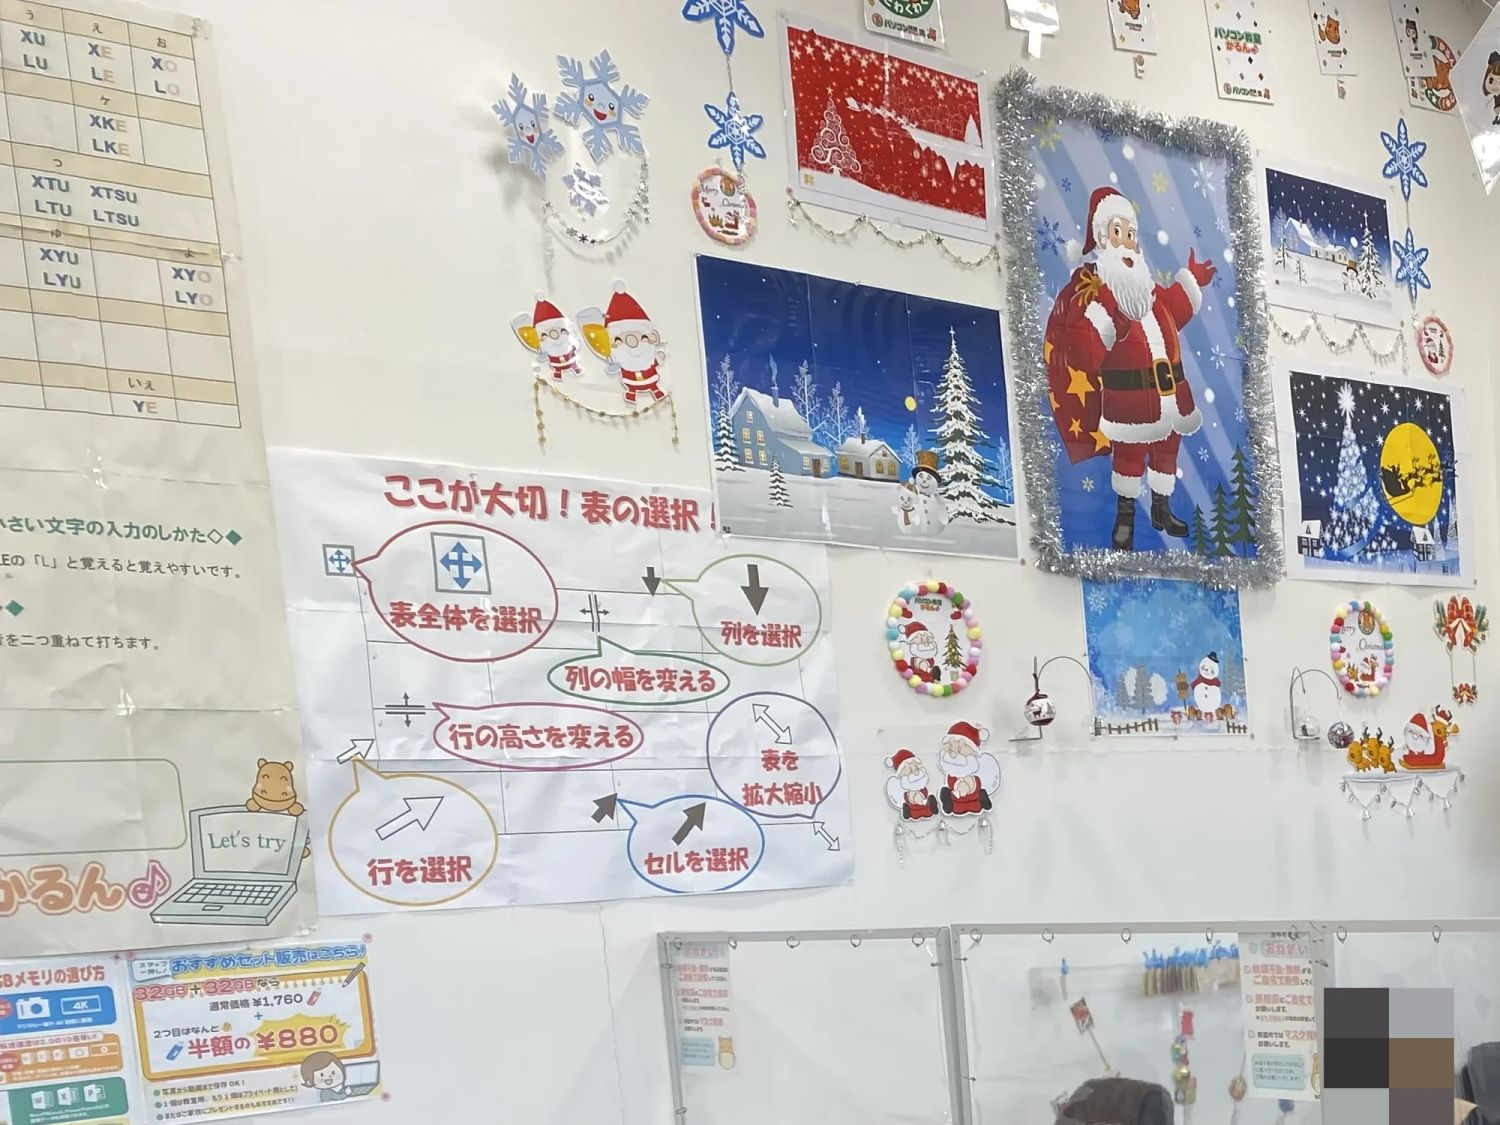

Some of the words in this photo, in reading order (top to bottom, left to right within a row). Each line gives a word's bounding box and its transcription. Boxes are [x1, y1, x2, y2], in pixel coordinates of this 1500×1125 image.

[20, 29, 46, 47] XU
[87, 43, 113, 59] XE
[23, 54, 48, 71] LU
[151, 56, 178, 73] XO
[91, 66, 115, 84] LE
[154, 80, 180, 96] LO
[89, 114, 128, 133] XKE
[92, 139, 130, 157] LKE
[31, 175, 70, 193] XTU
[90, 185, 138, 204] XTSU
[35, 200, 72, 218] LTU
[93, 209, 140, 227] LTSU
[40, 248, 79, 265] XYU
[43, 272, 82, 290] LYU
[172, 267, 211, 284] XYO
[175, 290, 213, 306] LYO
[133, 400, 158, 414] YE
[0, 553, 241, 579] Eの「L」と覚えると覚えやすいです。
[390, 601, 543, 634] 表全体を選択
[722, 620, 802, 648] 列を選択
[566, 665, 716, 693] 列の幅を変える
[450, 723, 634, 751] 行の高さを変える
[762, 749, 799, 771] 表を
[743, 783, 823, 806] 拡大縮小
[208, 832, 250, 850] Let's
[257, 832, 286, 853] try
[368, 855, 472, 885] 行を選択
[644, 849, 749, 873] セルを選択
[72, 1001, 88, 1009] 4K
